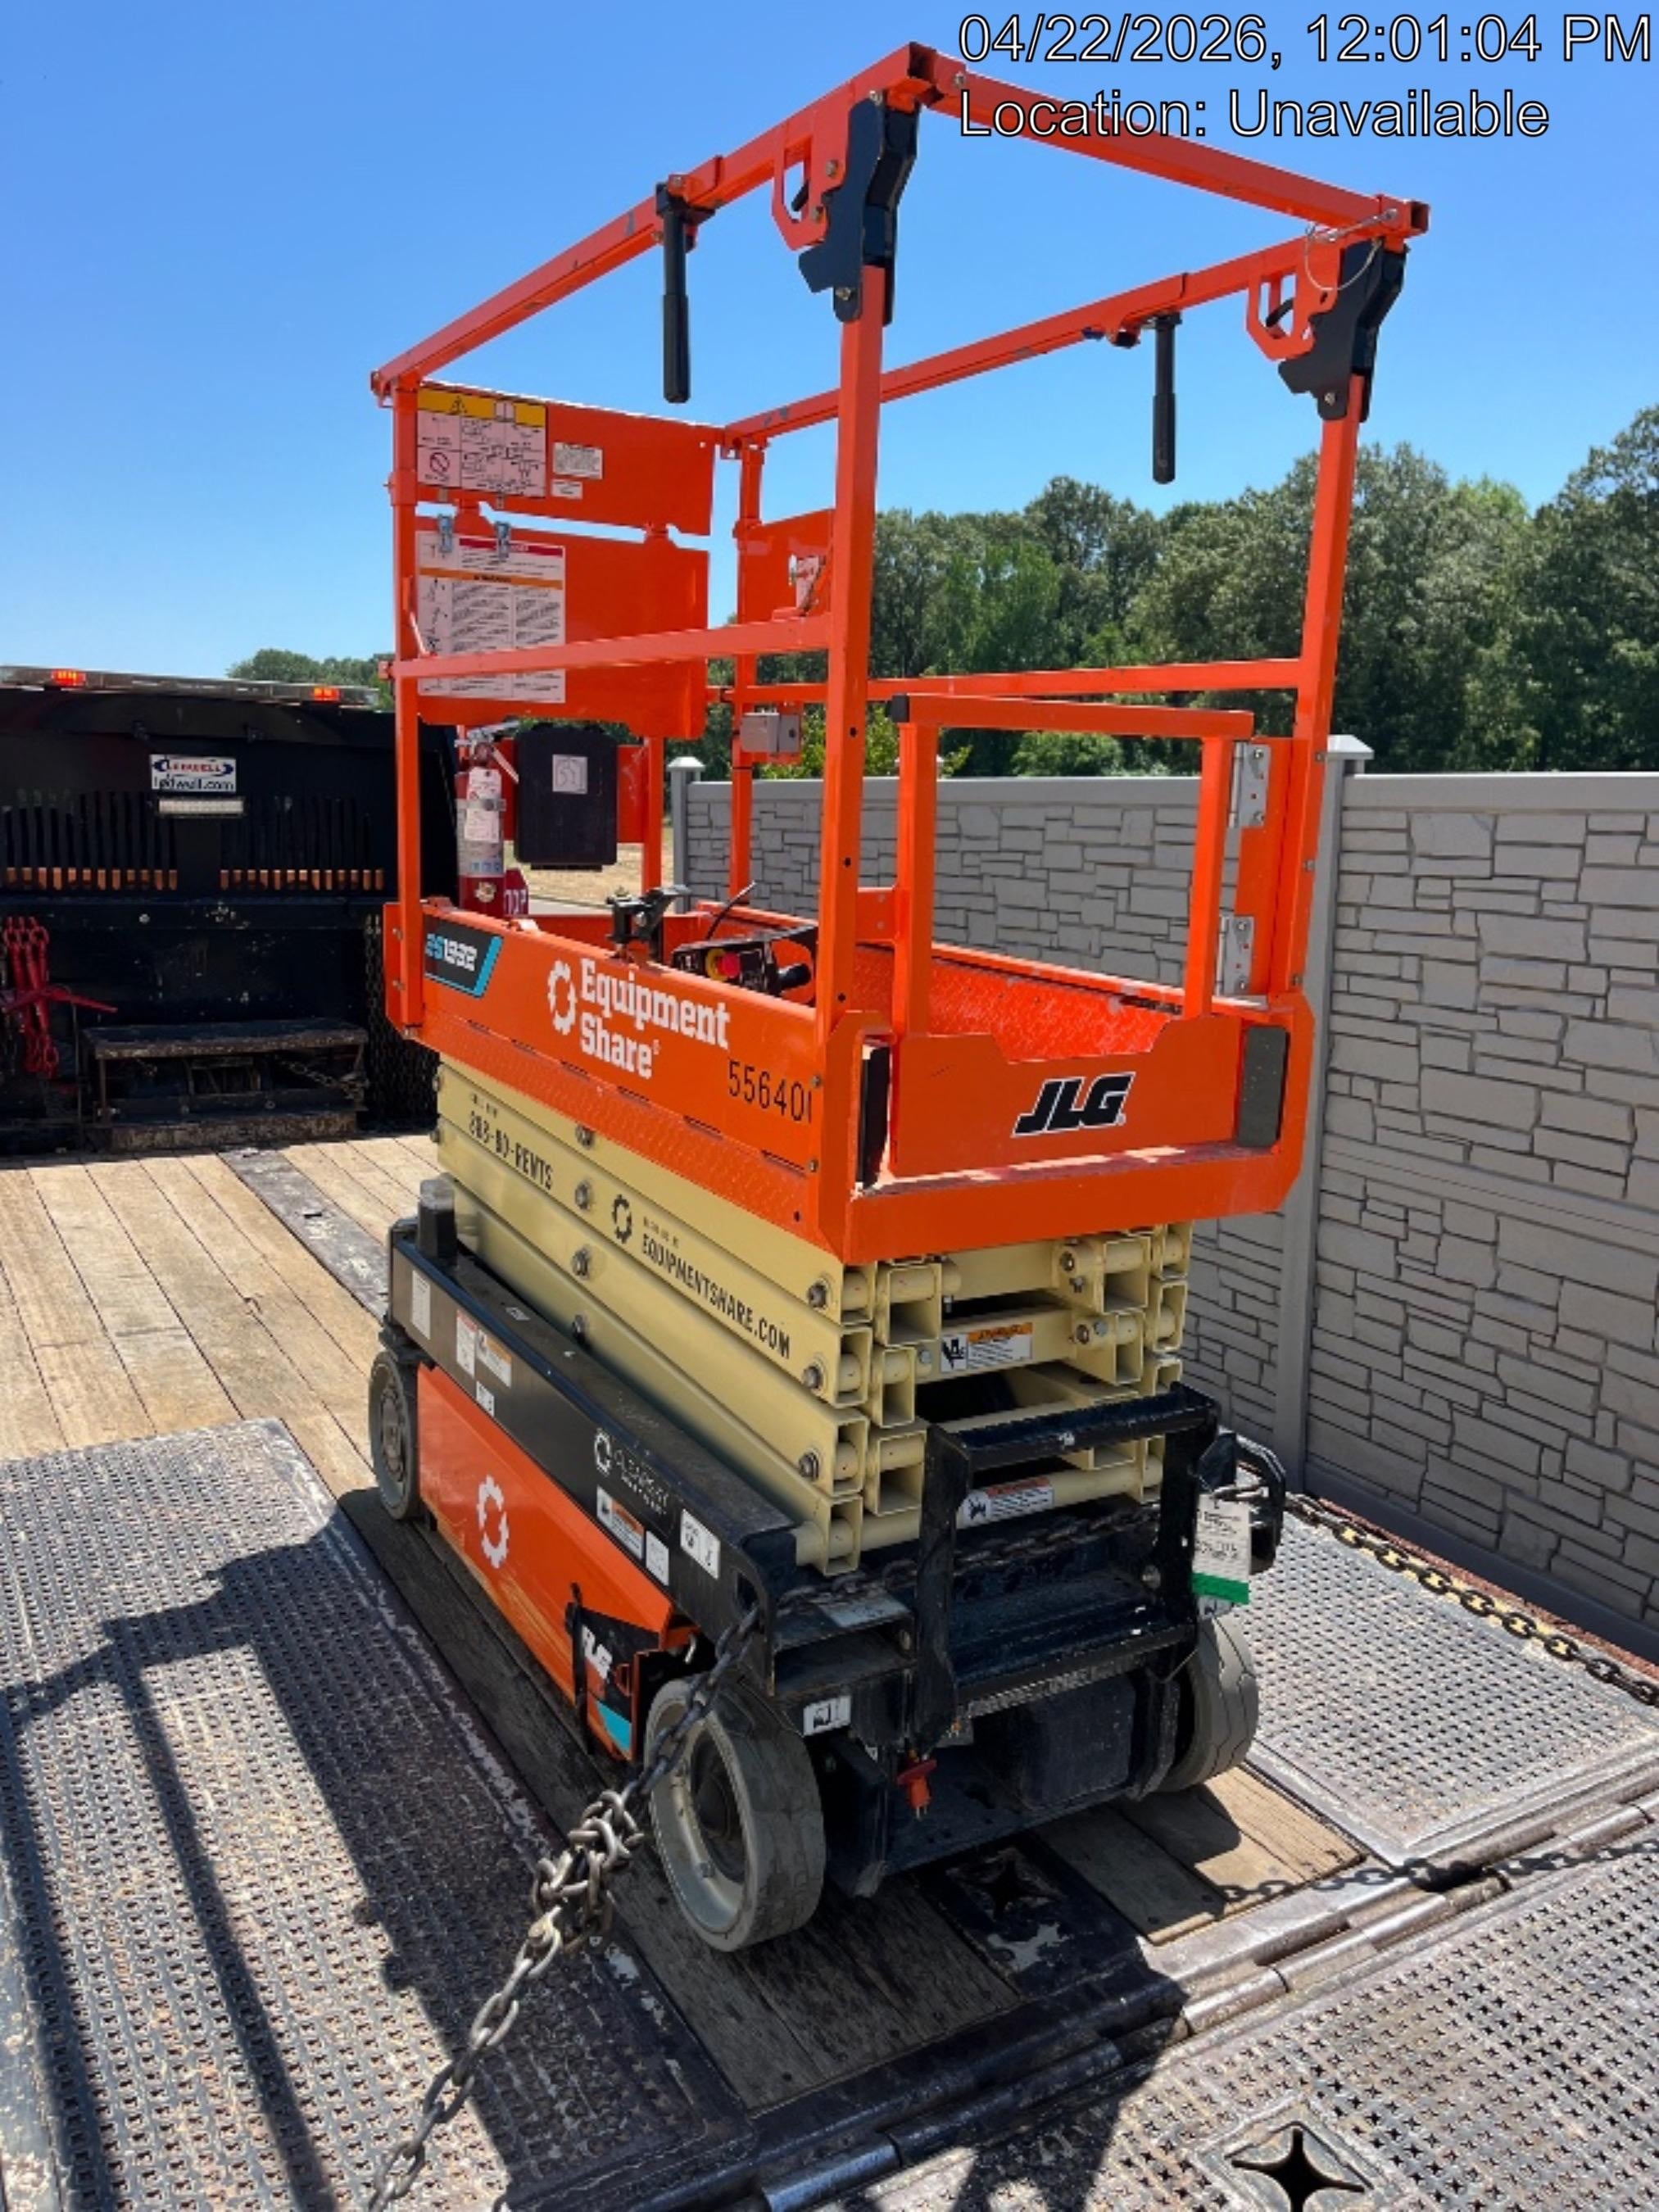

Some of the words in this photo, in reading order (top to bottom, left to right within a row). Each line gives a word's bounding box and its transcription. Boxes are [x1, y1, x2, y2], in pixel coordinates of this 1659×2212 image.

[581, 957, 730, 1050] Equipment
[728, 1060, 812, 1123] 556401
[1011, 1072, 1136, 1138] JLG
[642, 1233, 791, 1359] EQUIPMENTSHARE.COM
